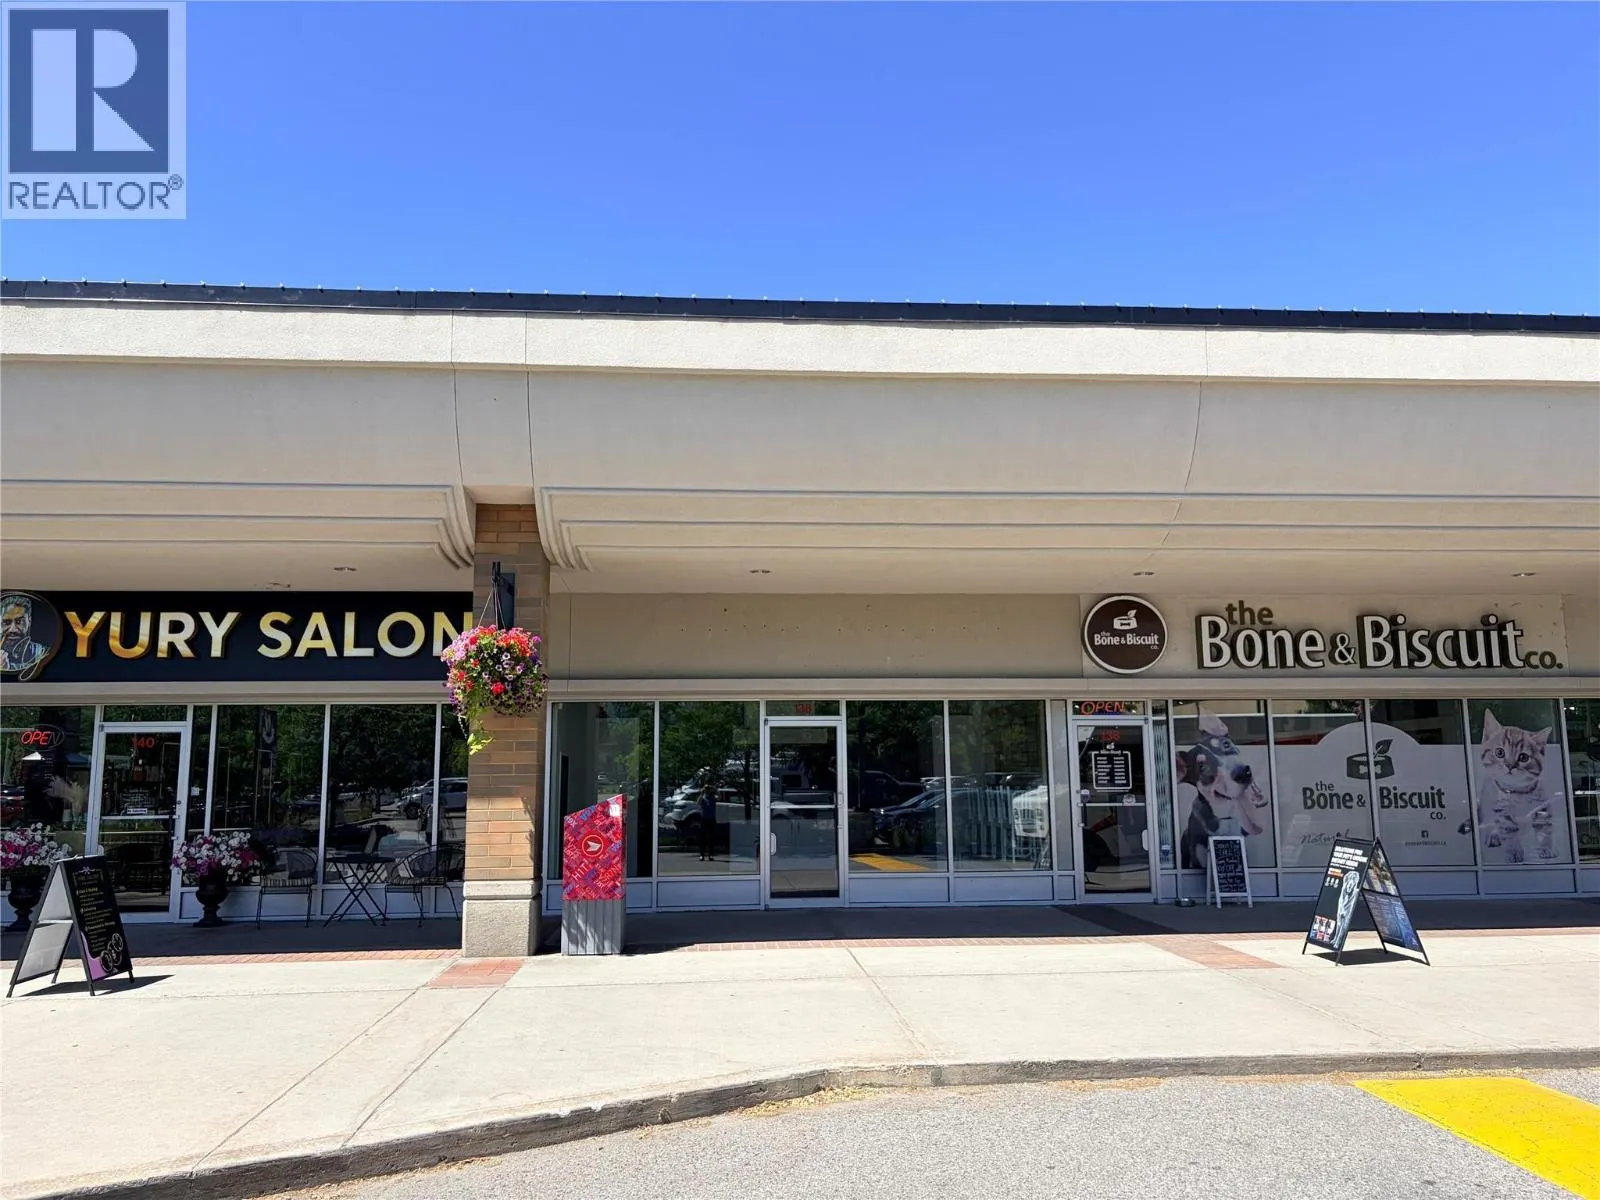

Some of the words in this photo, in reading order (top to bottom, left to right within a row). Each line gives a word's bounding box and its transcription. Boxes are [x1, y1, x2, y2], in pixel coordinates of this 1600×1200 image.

[1225, 600, 1274, 625] the
[64, 611, 241, 659] YURY
[257, 611, 473, 658] SALON
[1094, 633, 1120, 646] Bone
[1120, 637, 1126, 645] &
[1126, 632, 1159, 646] Biscuit
[1196, 614, 1326, 669] Bone
[1328, 632, 1357, 666] &
[1358, 614, 1526, 669] Biscuit
[1525, 650, 1564, 670] co.
[1081, 701, 1125, 715] OPEN
[21, 730, 61, 745] OPEN
[1315, 780, 1335, 792] the
[1302, 786, 1354, 810] Bone
[1356, 793, 1366, 808] &
[1379, 785, 1446, 809] Biscuit
[1430, 810, 1447, 820] co.
